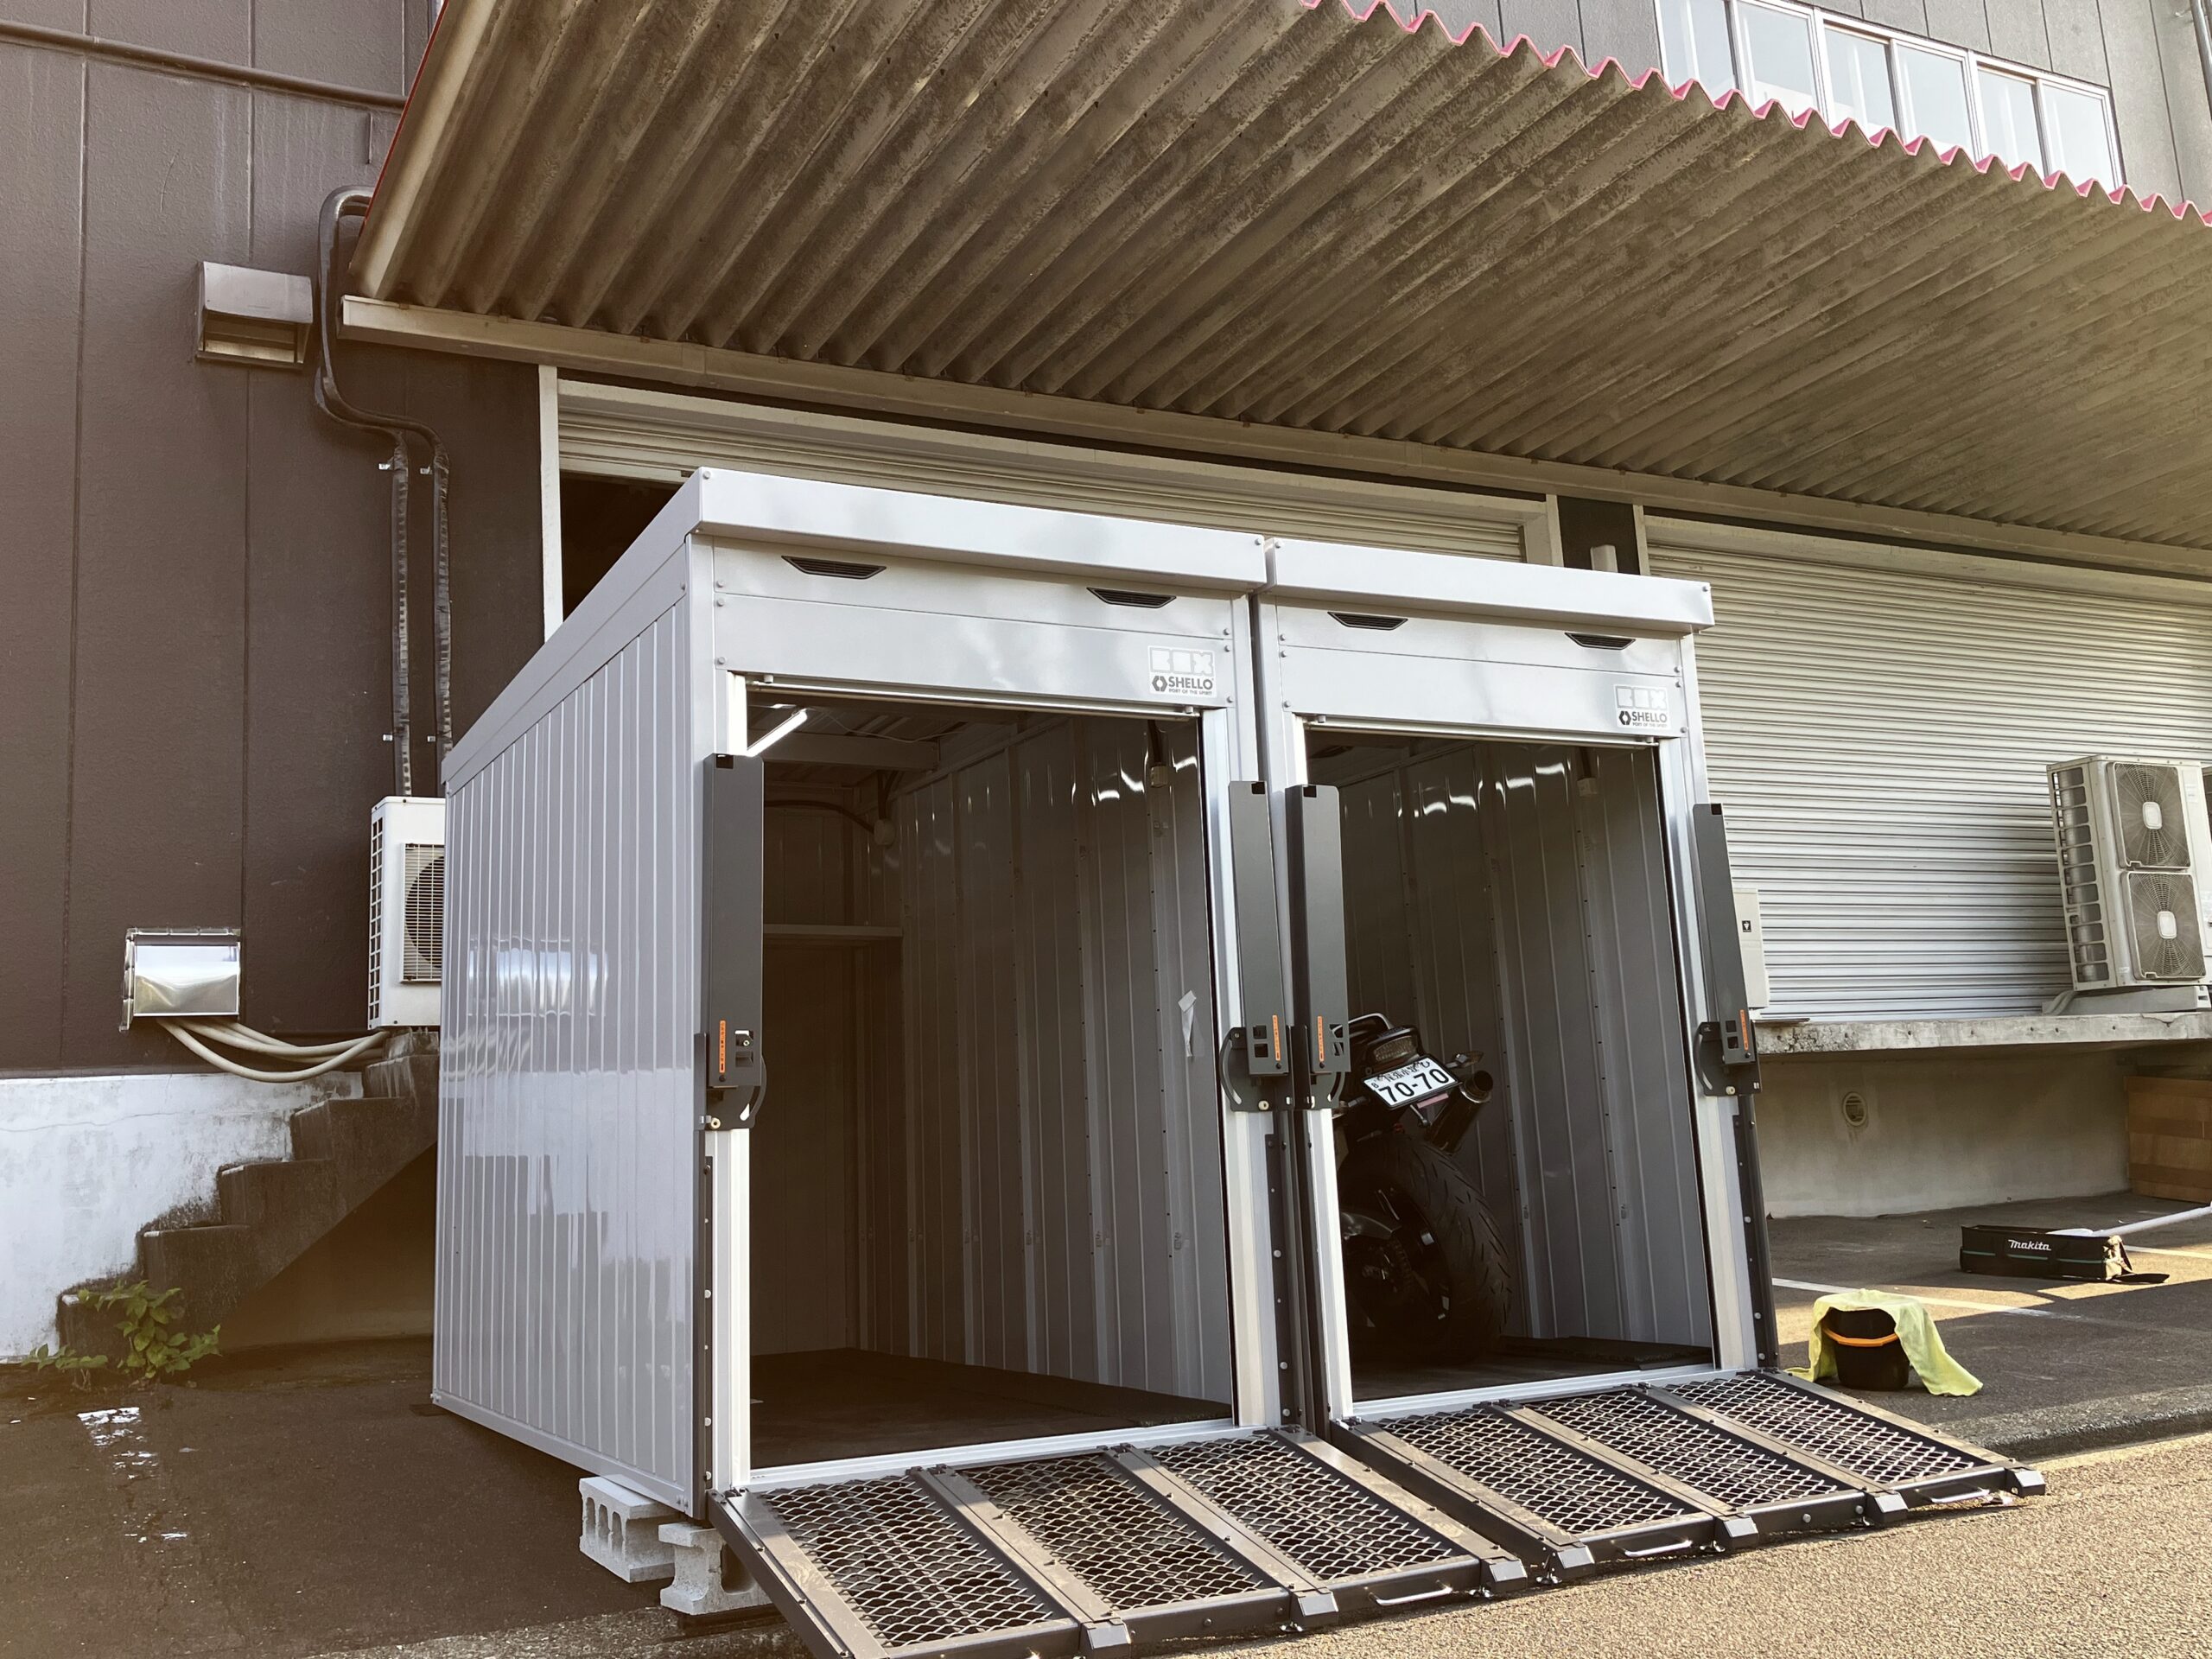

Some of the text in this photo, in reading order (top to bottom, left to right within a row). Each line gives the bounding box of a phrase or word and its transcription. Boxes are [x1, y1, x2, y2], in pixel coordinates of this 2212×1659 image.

[1168, 676, 1213, 690] SHELLO
[1631, 711, 1668, 723] SHELLO
[1378, 1068, 1449, 1103] 70-70
